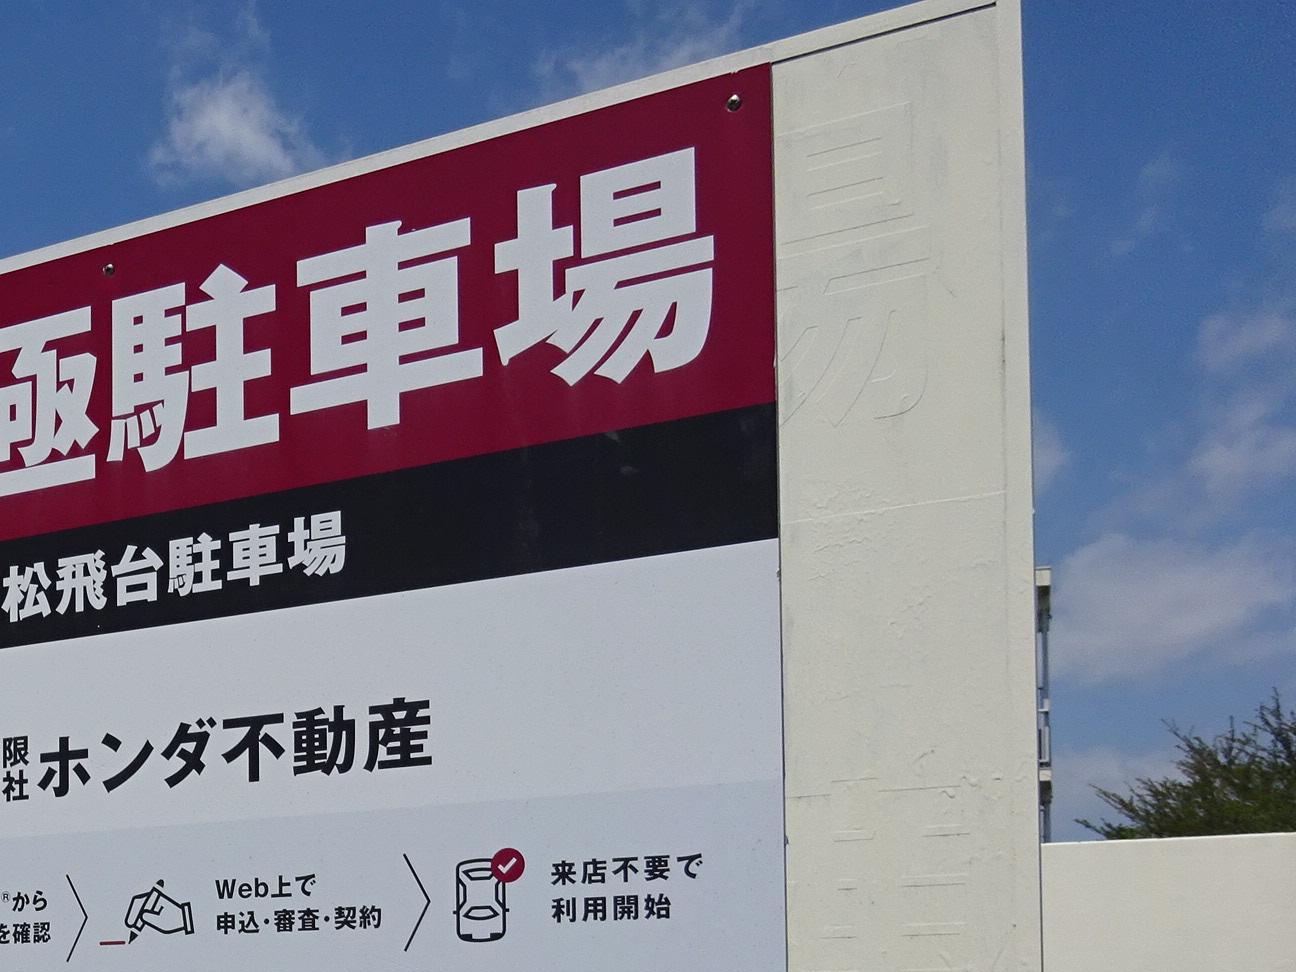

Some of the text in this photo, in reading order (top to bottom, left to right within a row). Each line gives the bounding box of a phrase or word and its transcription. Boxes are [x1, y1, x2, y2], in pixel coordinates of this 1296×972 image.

[37, 697, 433, 798] ホンダ不動産
[550, 852, 703, 886] 来店不要で
[214, 873, 316, 900] Web上で
[551, 893, 672, 924] 利用開始
